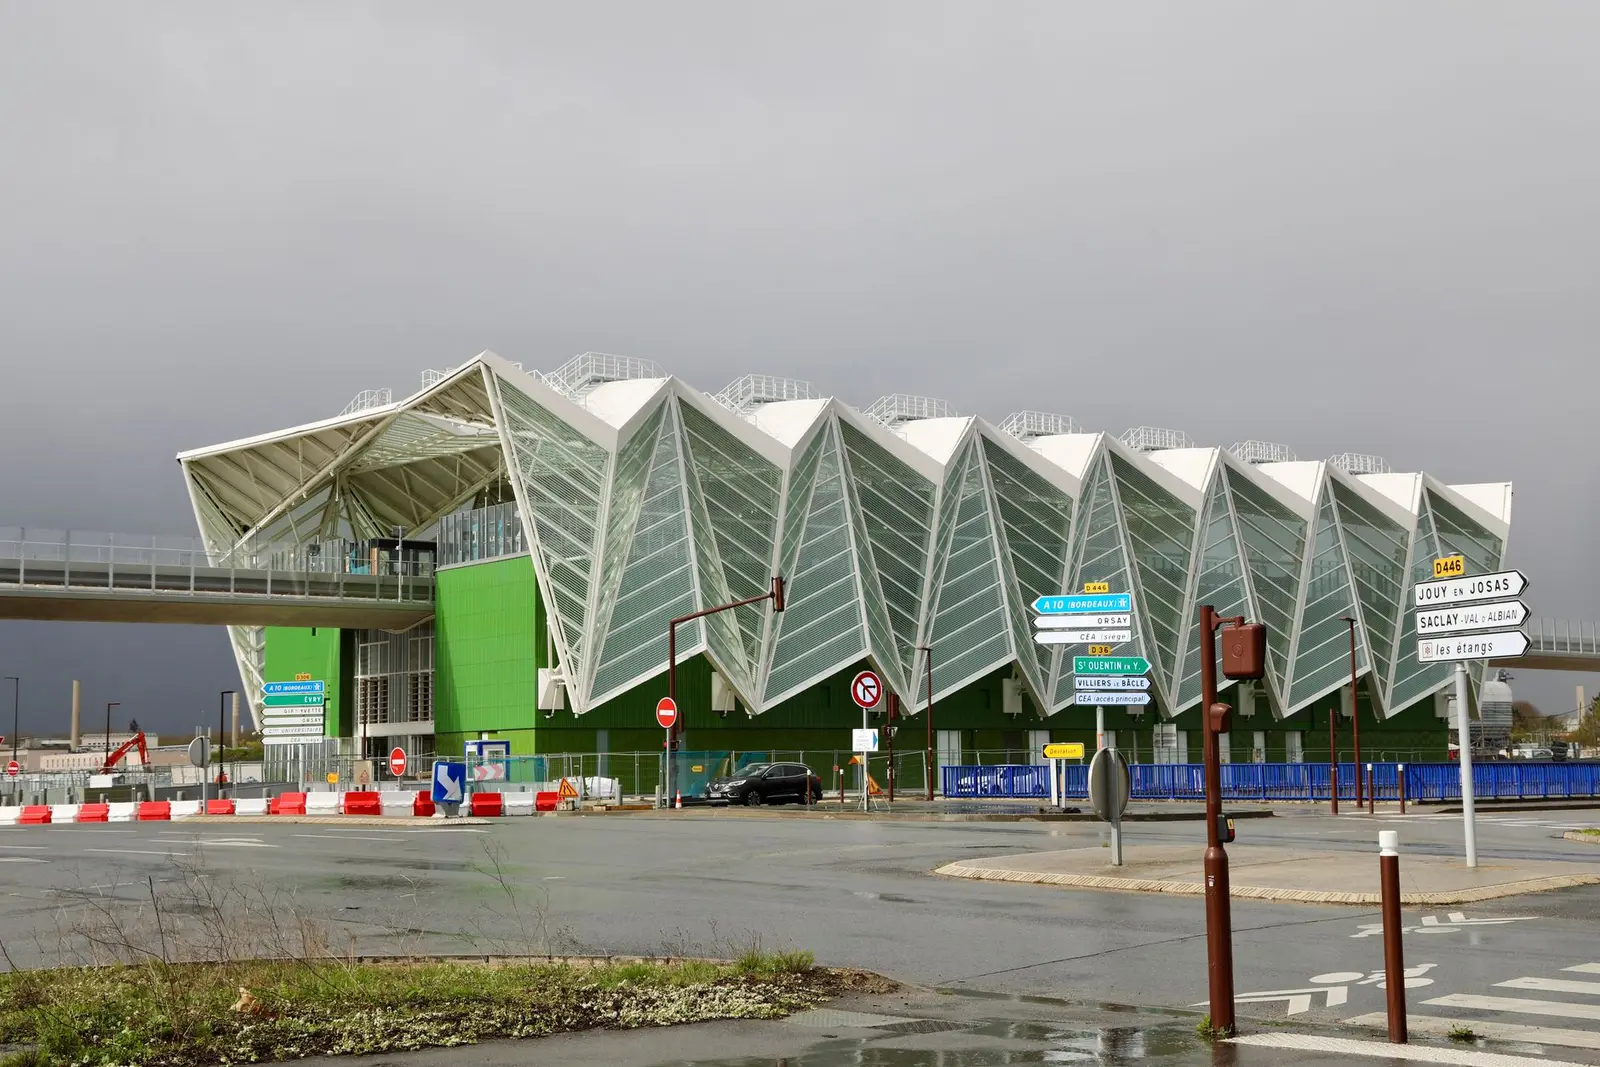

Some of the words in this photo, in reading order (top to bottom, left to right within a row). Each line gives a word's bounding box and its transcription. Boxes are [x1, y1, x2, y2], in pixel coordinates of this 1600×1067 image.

[1436, 560, 1462, 574] D446
[1419, 586, 1447, 600] JOUY
[1470, 578, 1510, 594] JOSAS
[1068, 600, 1116, 608] (BORDEAUX)
[1420, 614, 1458, 628] SACLAY
[1436, 644, 1450, 656] les
[1457, 642, 1493, 656] étangs
[1088, 661, 1122, 670] QUENTIN
[1122, 678, 1144, 686] BÂCLE
[1116, 694, 1146, 703] principal)
